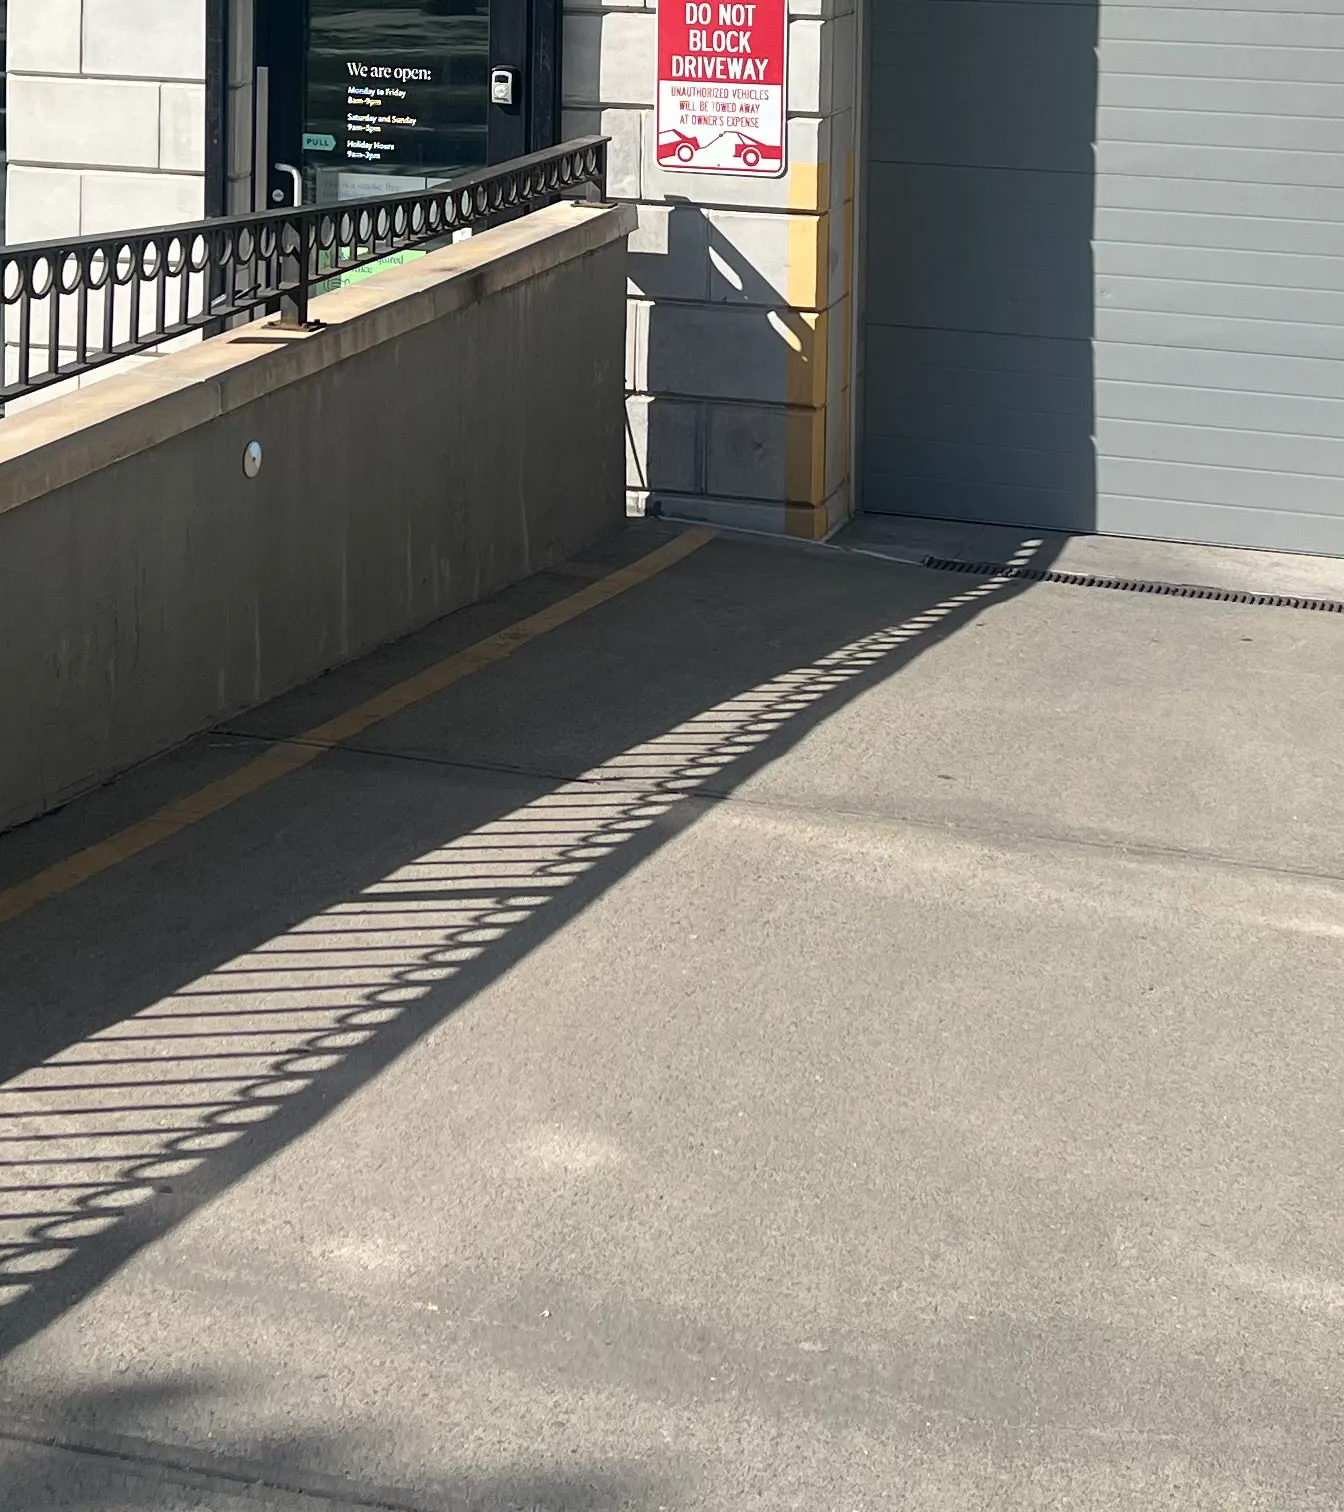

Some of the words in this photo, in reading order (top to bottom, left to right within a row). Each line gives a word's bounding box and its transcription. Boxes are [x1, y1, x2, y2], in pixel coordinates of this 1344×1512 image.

[684, 1, 712, 26] DO
[718, 3, 757, 27] NOT
[688, 29, 752, 54] BLOCK
[347, 62, 368, 78] We
[370, 66, 392, 79] are
[393, 67, 432, 83] open:
[671, 55, 769, 81] DRIVEWAY
[385, 88, 407, 99] Friday
[670, 85, 729, 99] UNAUTHORIZED
[731, 88, 769, 101] VEHICLES
[679, 100, 697, 112] WILL
[699, 100, 709, 112] BE
[711, 101, 737, 113] TOWED
[739, 103, 761, 114] AWAY
[679, 114, 690, 125] AT
[691, 115, 724, 127] OWNER'S
[726, 116, 760, 128] EXPENSE
[306, 138, 329, 147] PULL
